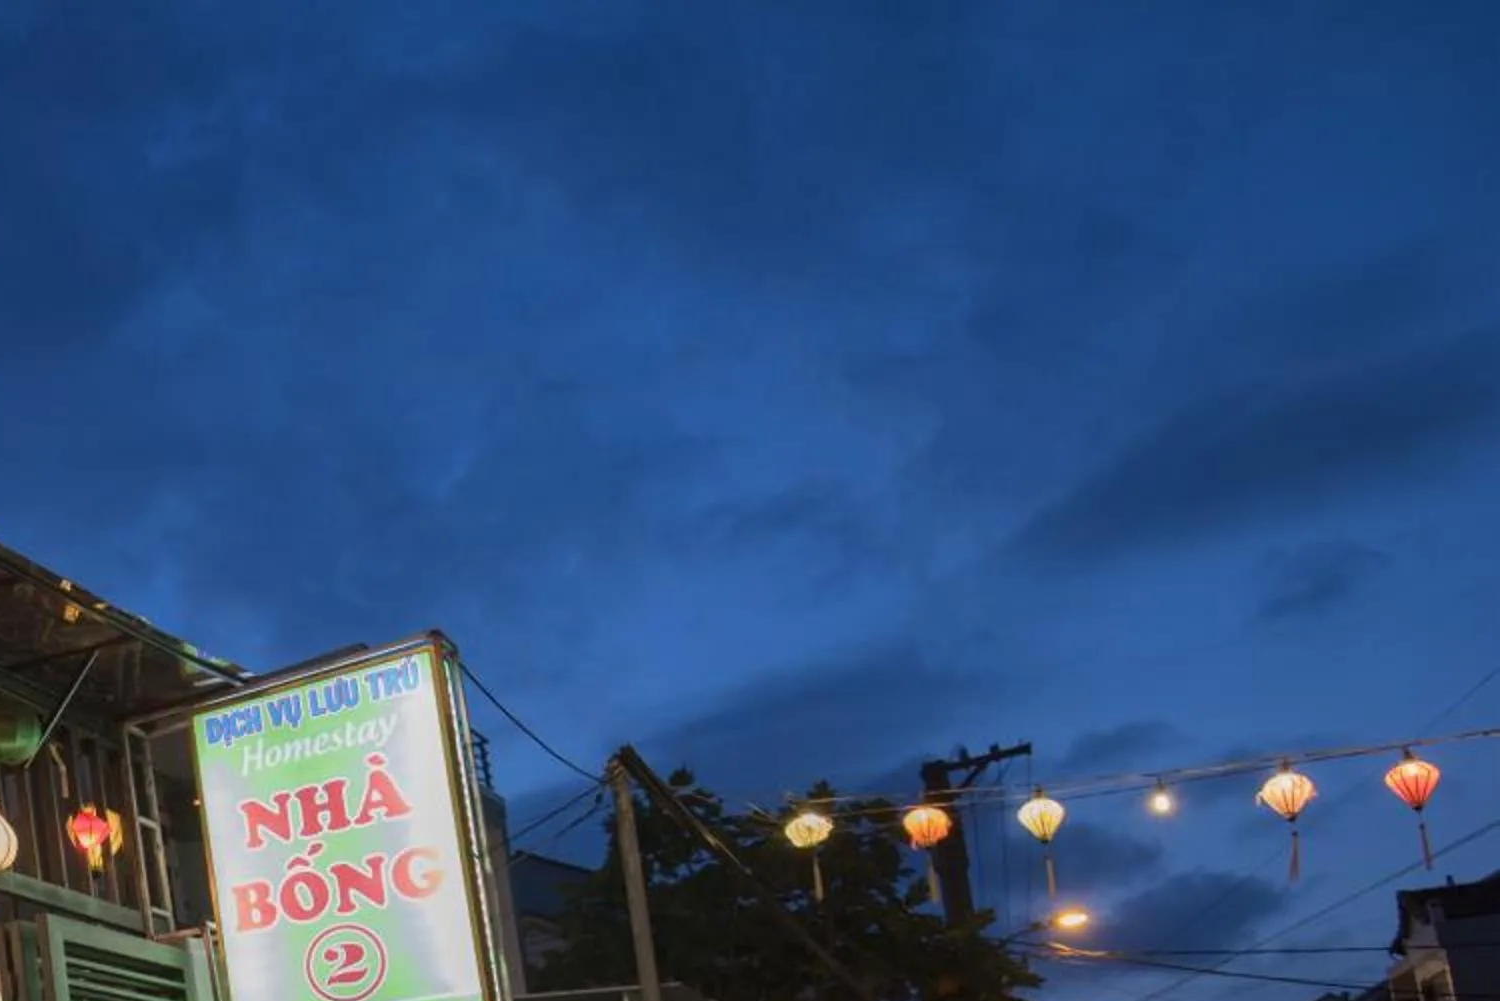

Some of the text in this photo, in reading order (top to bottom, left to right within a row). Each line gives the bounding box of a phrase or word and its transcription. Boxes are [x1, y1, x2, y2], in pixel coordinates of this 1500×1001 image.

[206, 705, 263, 747] DỊCH
[268, 693, 302, 728] VỤ
[364, 657, 419, 700] TRÚ
[240, 712, 399, 777] Homestay
[240, 752, 412, 849] NHÀ
[231, 842, 445, 933] BỐNG
[323, 943, 368, 986] 2
